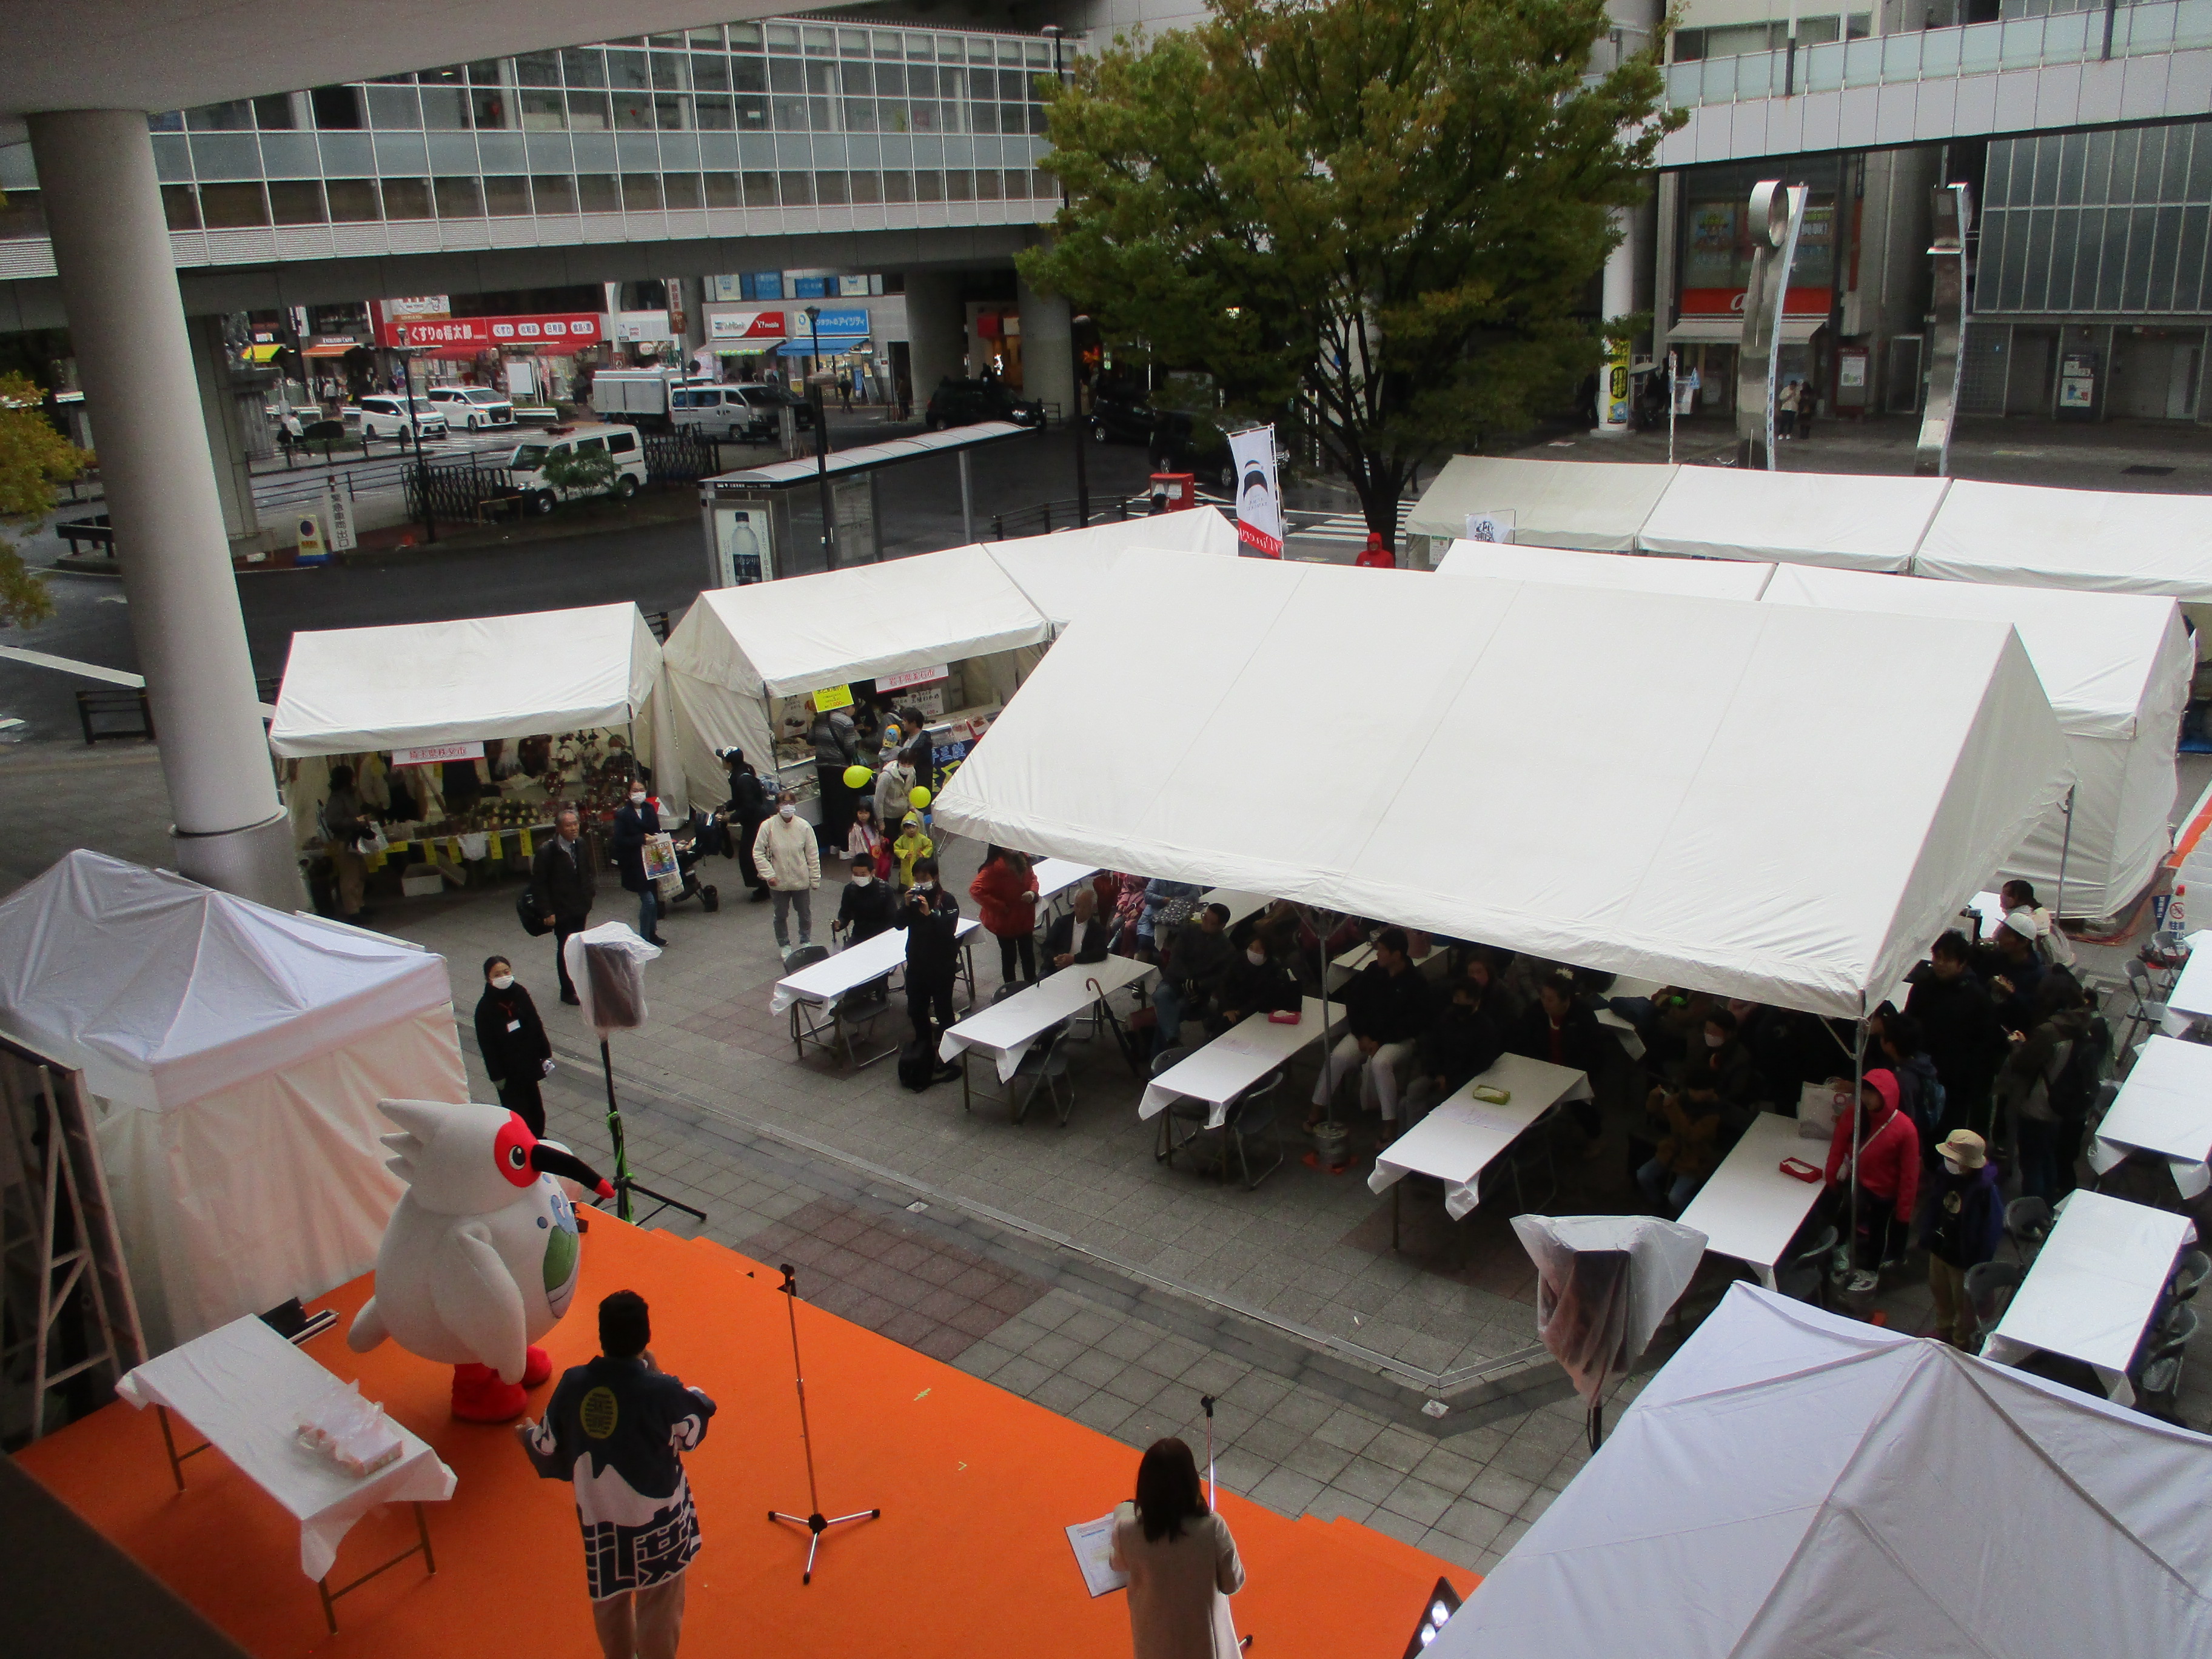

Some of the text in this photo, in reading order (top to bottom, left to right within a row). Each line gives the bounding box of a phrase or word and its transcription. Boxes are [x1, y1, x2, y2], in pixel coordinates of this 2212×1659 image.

[411, 324, 473, 342] くすりの福太郎
[495, 326, 511, 335] くすり
[889, 668, 935, 686] 岩手県釜石市
[409, 746, 468, 759] 埼玉県秩父市
